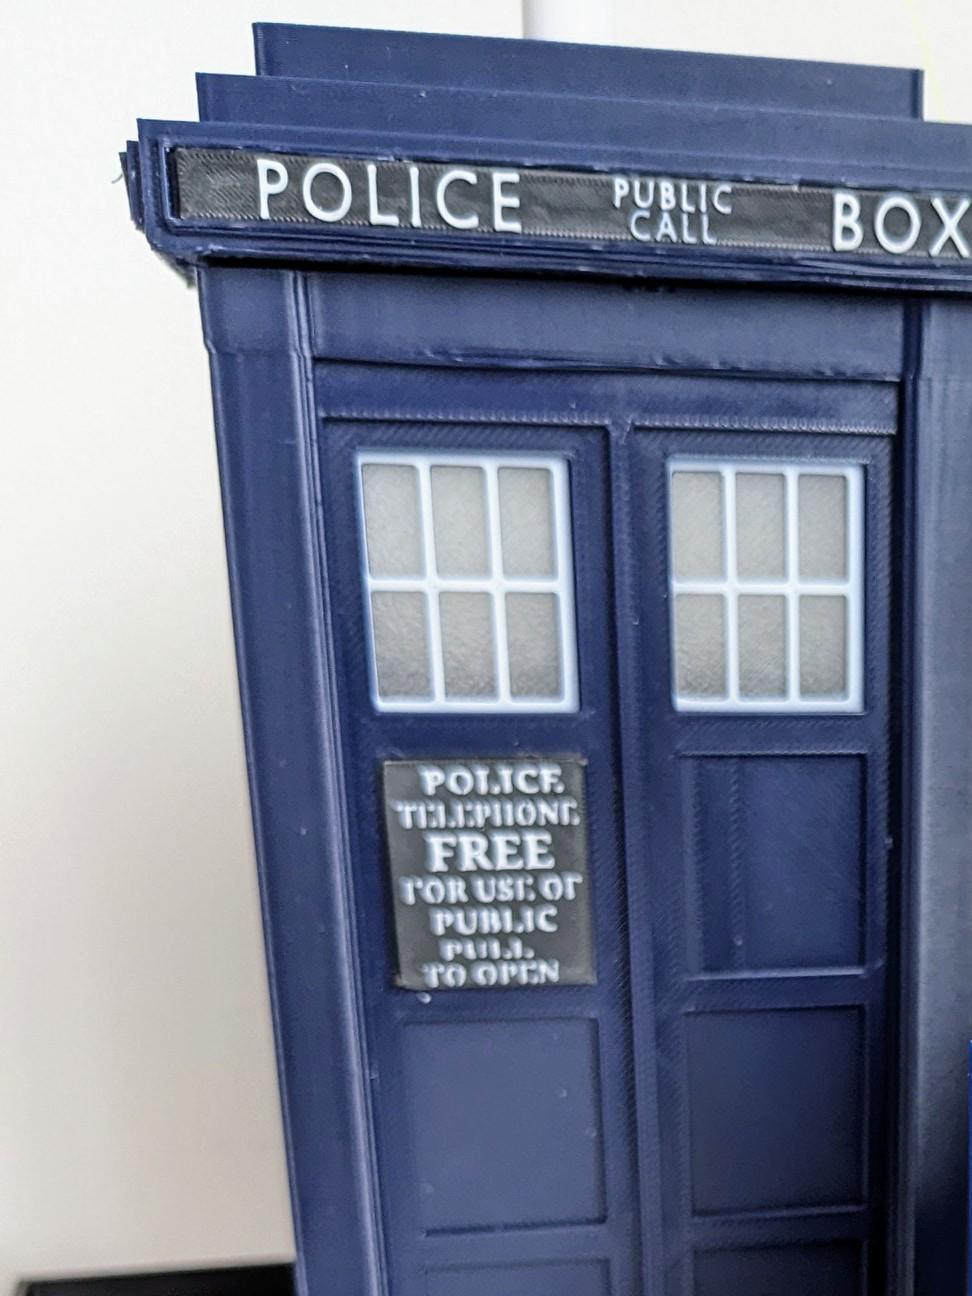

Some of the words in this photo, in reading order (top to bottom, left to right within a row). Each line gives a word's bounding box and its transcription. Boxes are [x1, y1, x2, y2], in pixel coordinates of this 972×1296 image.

[257, 159, 521, 233] POLICE
[613, 178, 732, 214] PUBLIC
[833, 193, 970, 258] BOX
[630, 211, 717, 244] CALL
[418, 764, 565, 795] POLICE
[393, 797, 581, 829] TELEPHONE
[423, 830, 556, 872] FREE
[400, 875, 469, 905] FOR
[471, 875, 536, 903] USE
[538, 872, 583, 901] OF
[429, 905, 558, 935] PUBLIC
[439, 936, 535, 961] PULL
[422, 961, 467, 988] TO
[471, 959, 560, 986] OPEN
